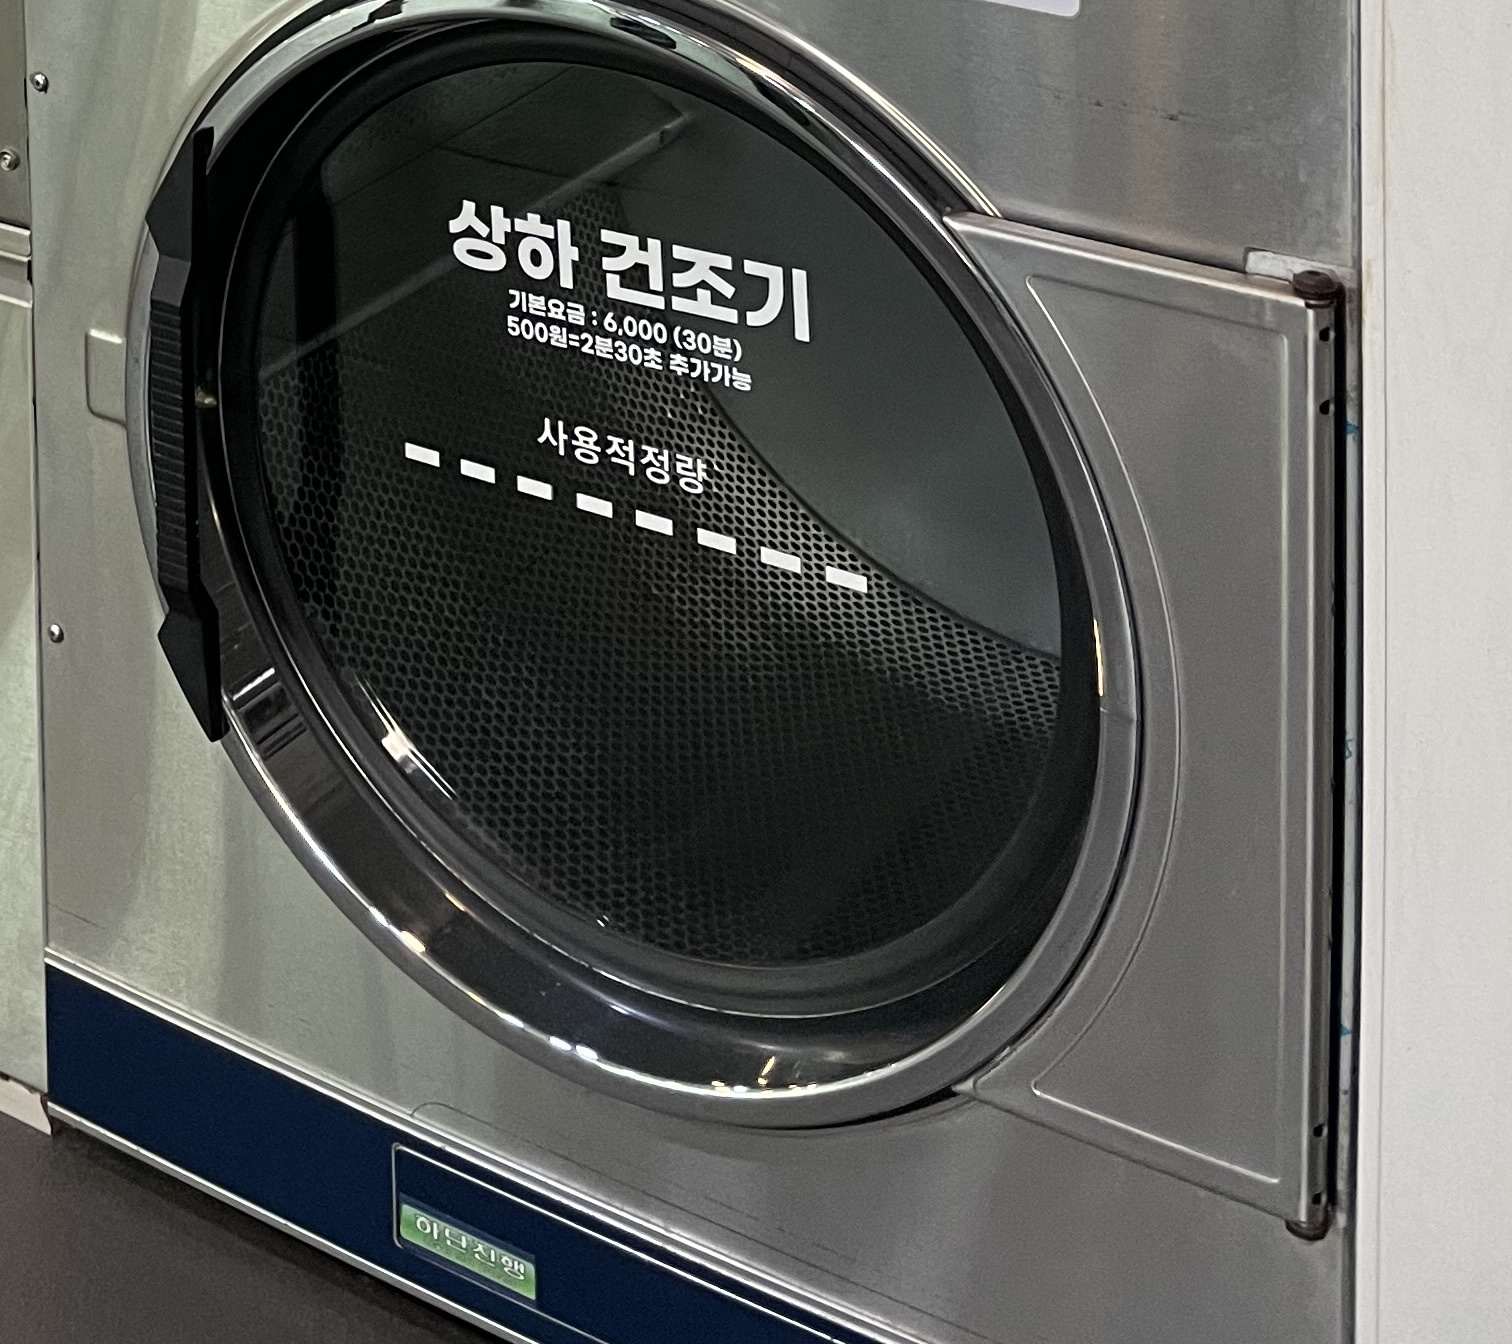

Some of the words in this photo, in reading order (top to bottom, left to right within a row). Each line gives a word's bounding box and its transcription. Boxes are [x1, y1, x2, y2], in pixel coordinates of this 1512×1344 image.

[449, 200, 579, 289] 상하
[601, 229, 810, 342] 건조기
[508, 316, 663, 370] 500원=2분30초
[670, 354, 752, 391] 추가가능
[509, 289, 585, 325] 기본요금
[604, 312, 667, 343] 6,000
[673, 326, 742, 361] (30분)
[538, 418, 710, 493] 사용적정량
[414, 1214, 526, 1281] 하단진행
